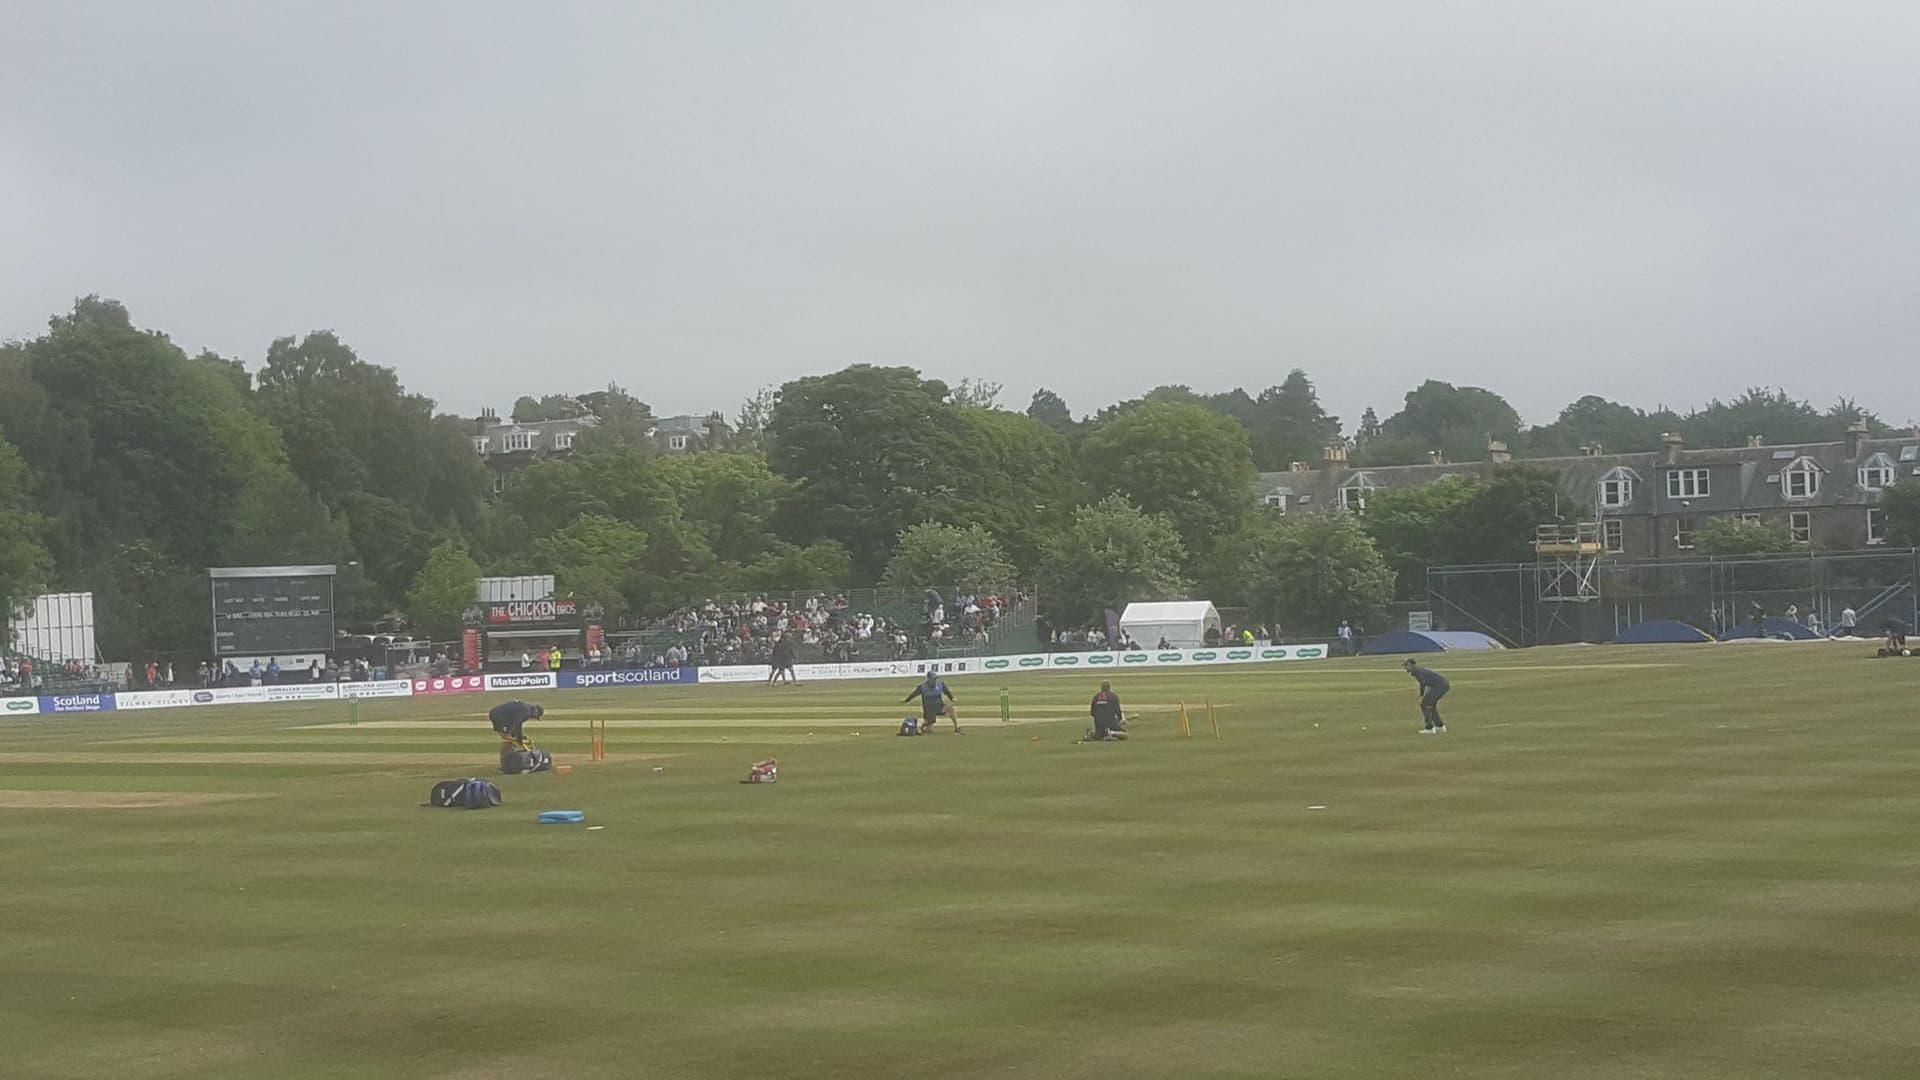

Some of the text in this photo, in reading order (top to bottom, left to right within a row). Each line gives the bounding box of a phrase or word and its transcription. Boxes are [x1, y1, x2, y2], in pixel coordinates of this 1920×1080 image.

[491, 601, 577, 617] THE CHICKEN BROS
[492, 676, 549, 686] MatchPoint
[576, 669, 680, 686] sportscotland
[53, 694, 100, 706] Scotland
